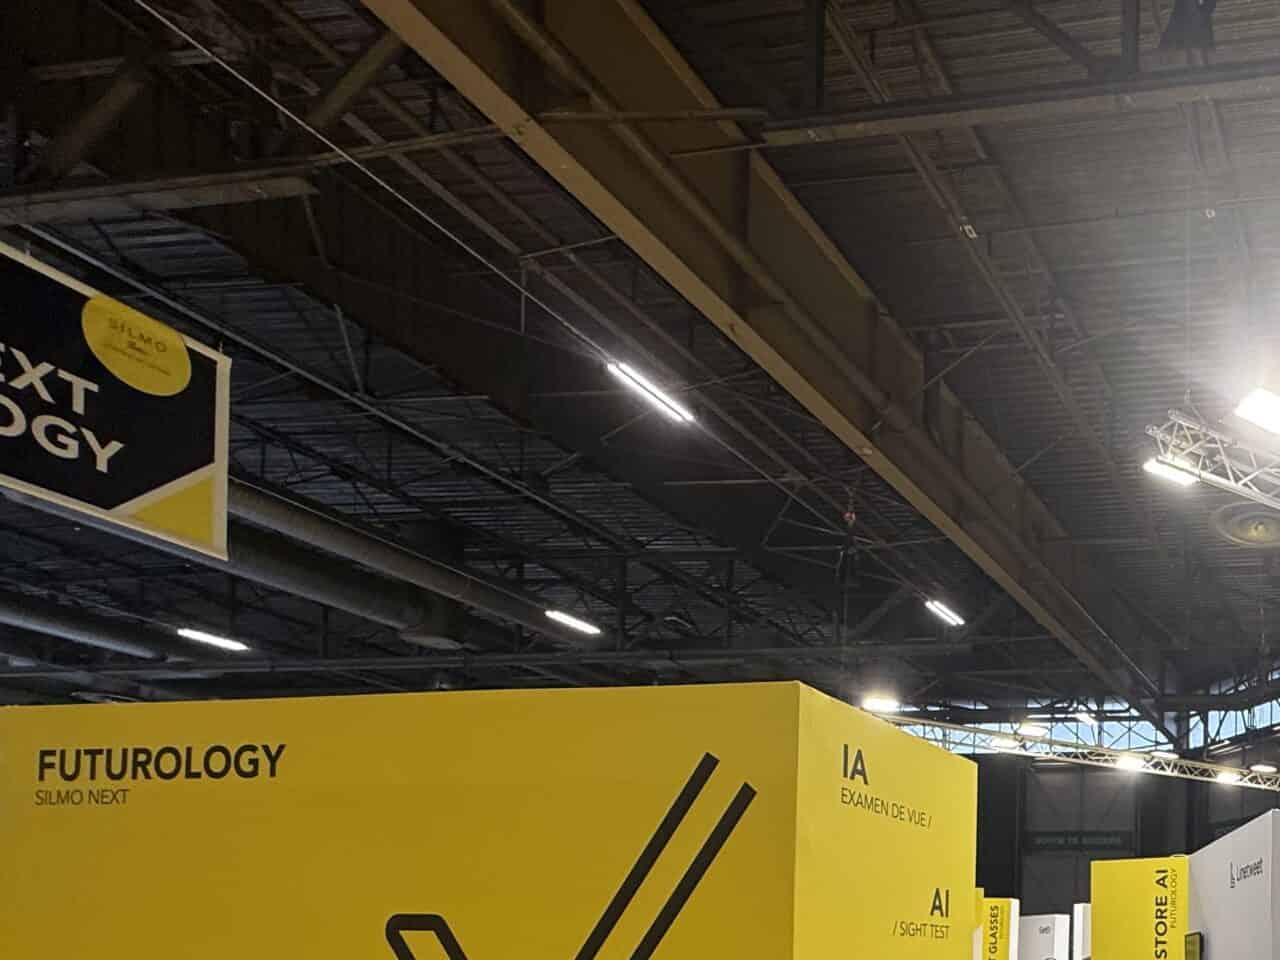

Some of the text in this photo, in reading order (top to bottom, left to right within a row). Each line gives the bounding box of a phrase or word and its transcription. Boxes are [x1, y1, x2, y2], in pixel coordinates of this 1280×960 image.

[0, 342, 98, 415] XT
[38, 744, 286, 781] FUTUROLOGY
[842, 744, 869, 785] IA
[35, 788, 130, 806] SILMO NEXT
[841, 787, 889, 817] EXAMEN
[891, 802, 905, 821] DE
[908, 808, 926, 828] VUE
[930, 887, 950, 918] AI
[1154, 869, 1168, 960] STORE AI
[900, 922, 928, 938] SIGHT
[930, 924, 950, 940] TEST
[988, 905, 999, 953] GLASSES
